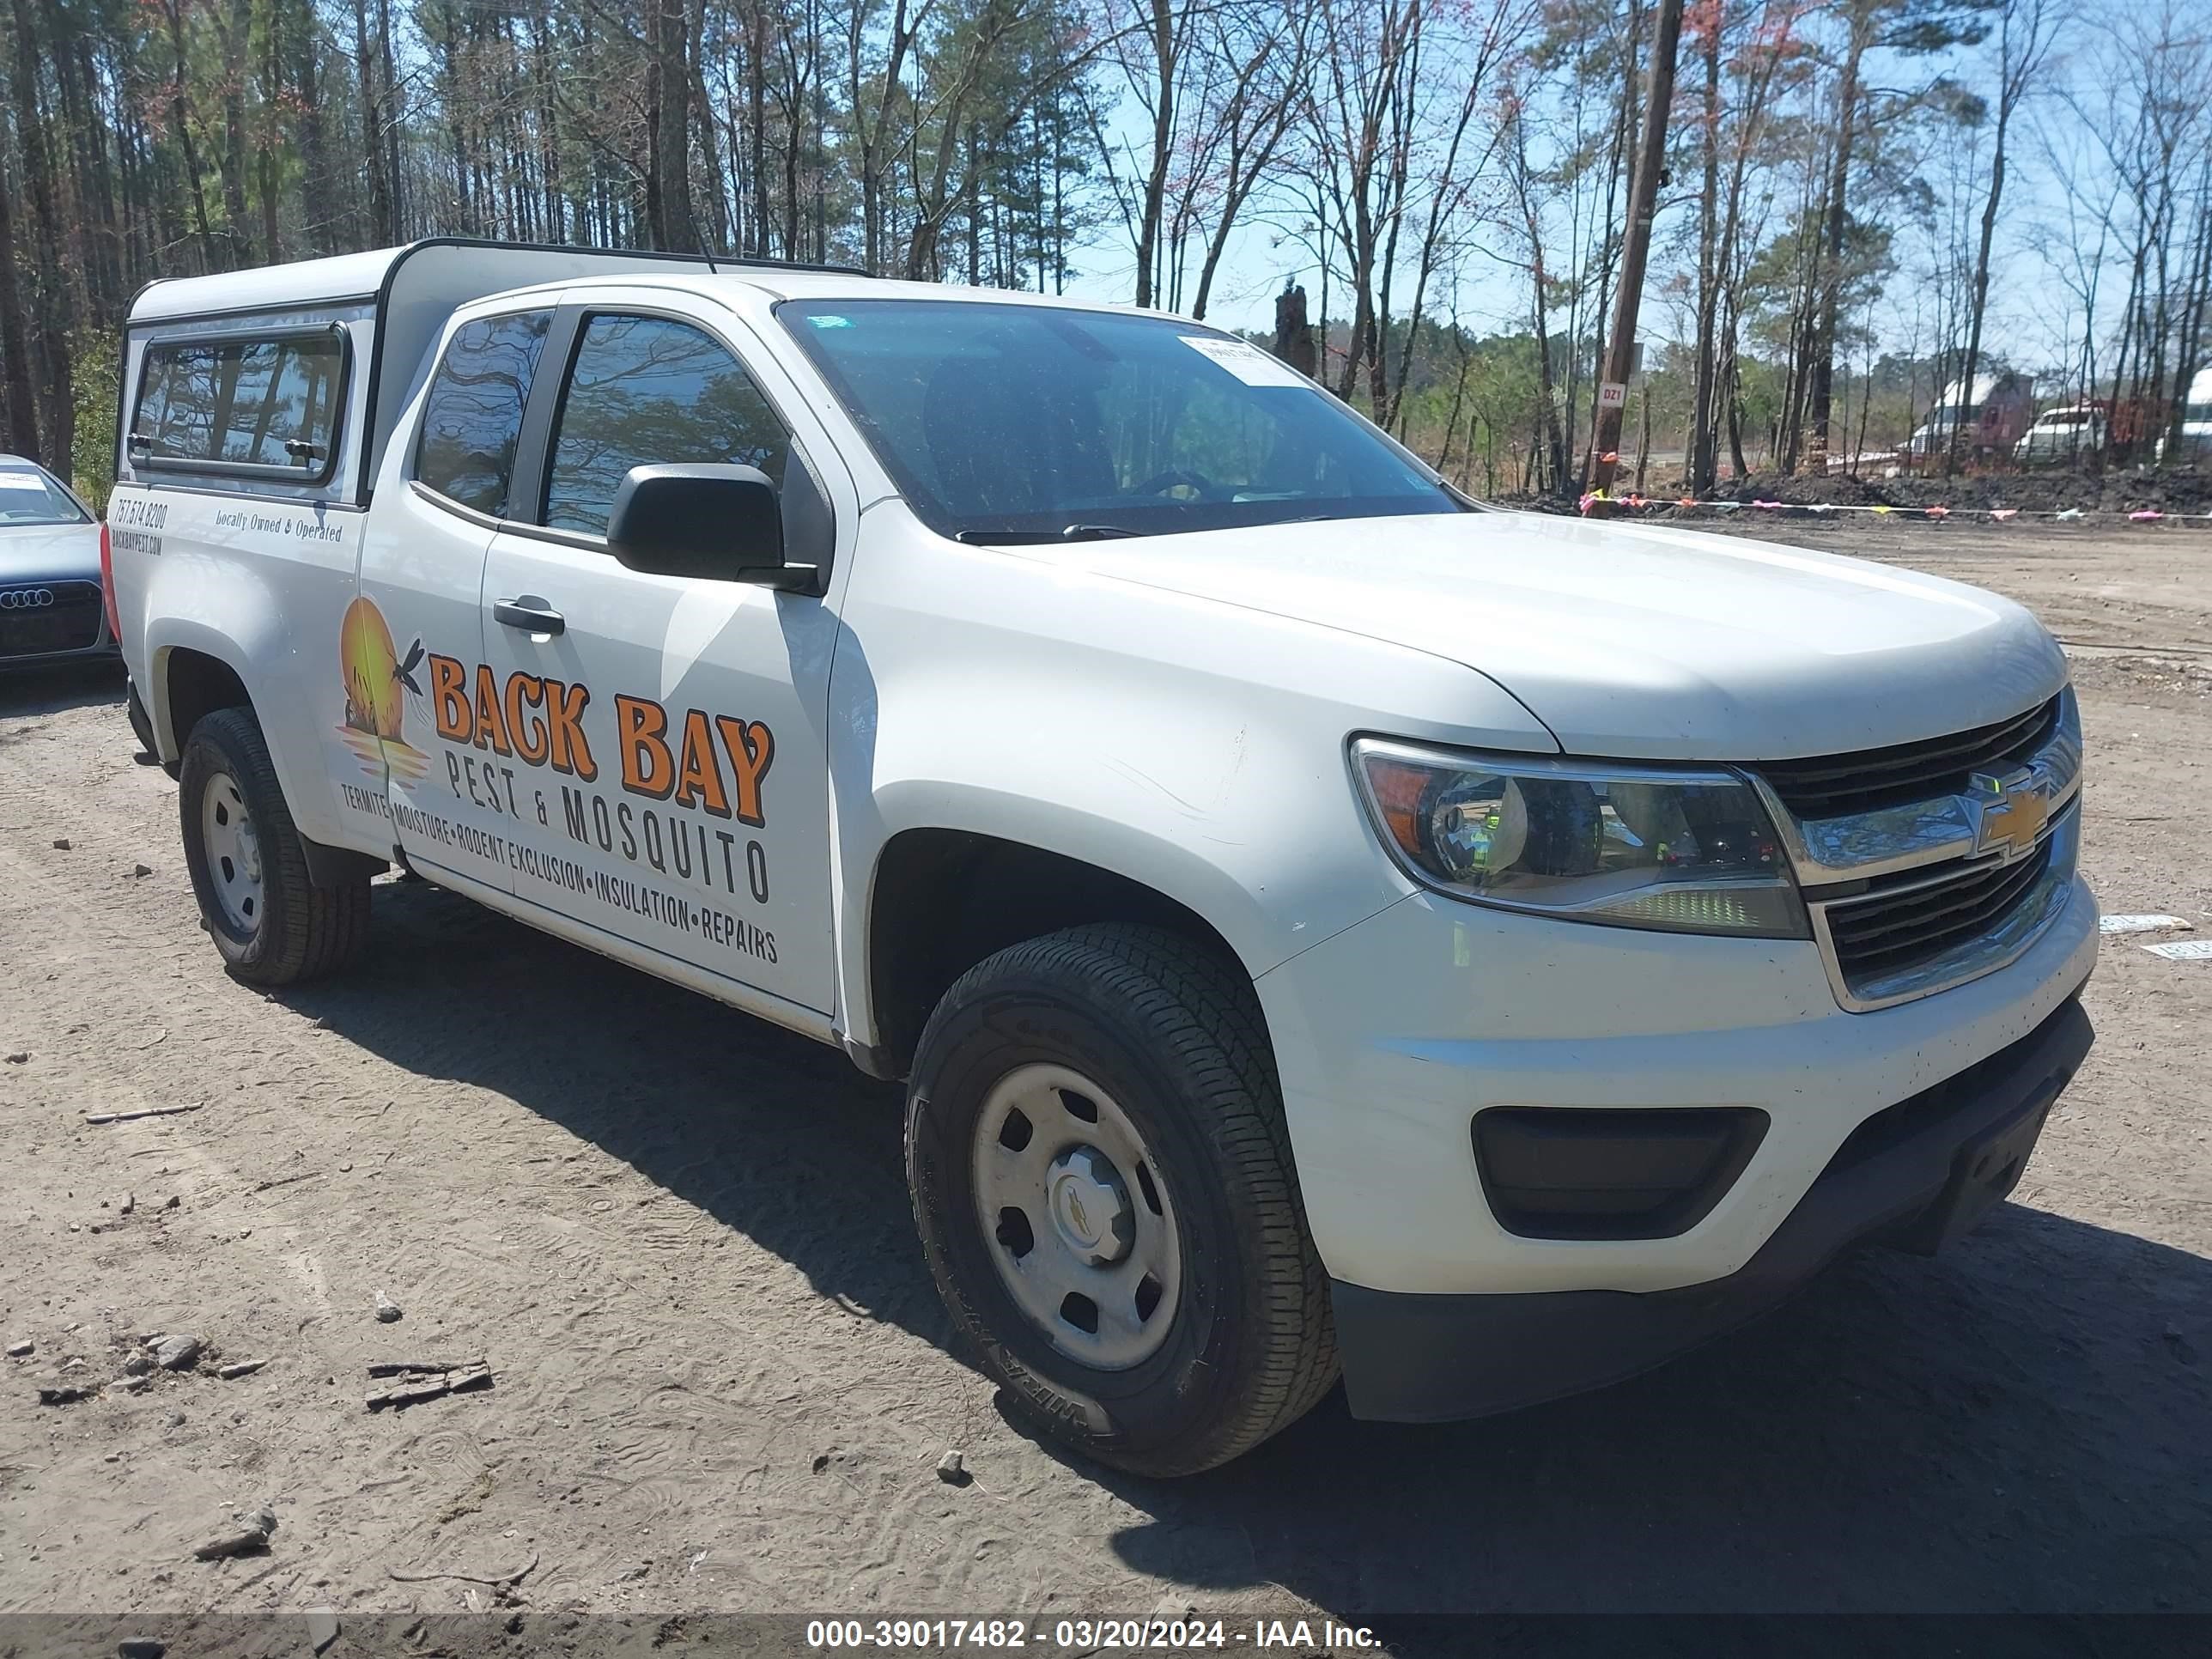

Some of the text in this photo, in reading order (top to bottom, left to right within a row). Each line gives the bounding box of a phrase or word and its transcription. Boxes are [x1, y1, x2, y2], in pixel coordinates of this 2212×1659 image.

[114, 499, 168, 529] 757.574.8200
[216, 509, 343, 543] Locally Owned & Operated
[112, 528, 162, 556] BACKBAYPEST.COM
[428, 653, 775, 829] BACK BAY
[444, 750, 769, 904] PEST & MOSQUITO
